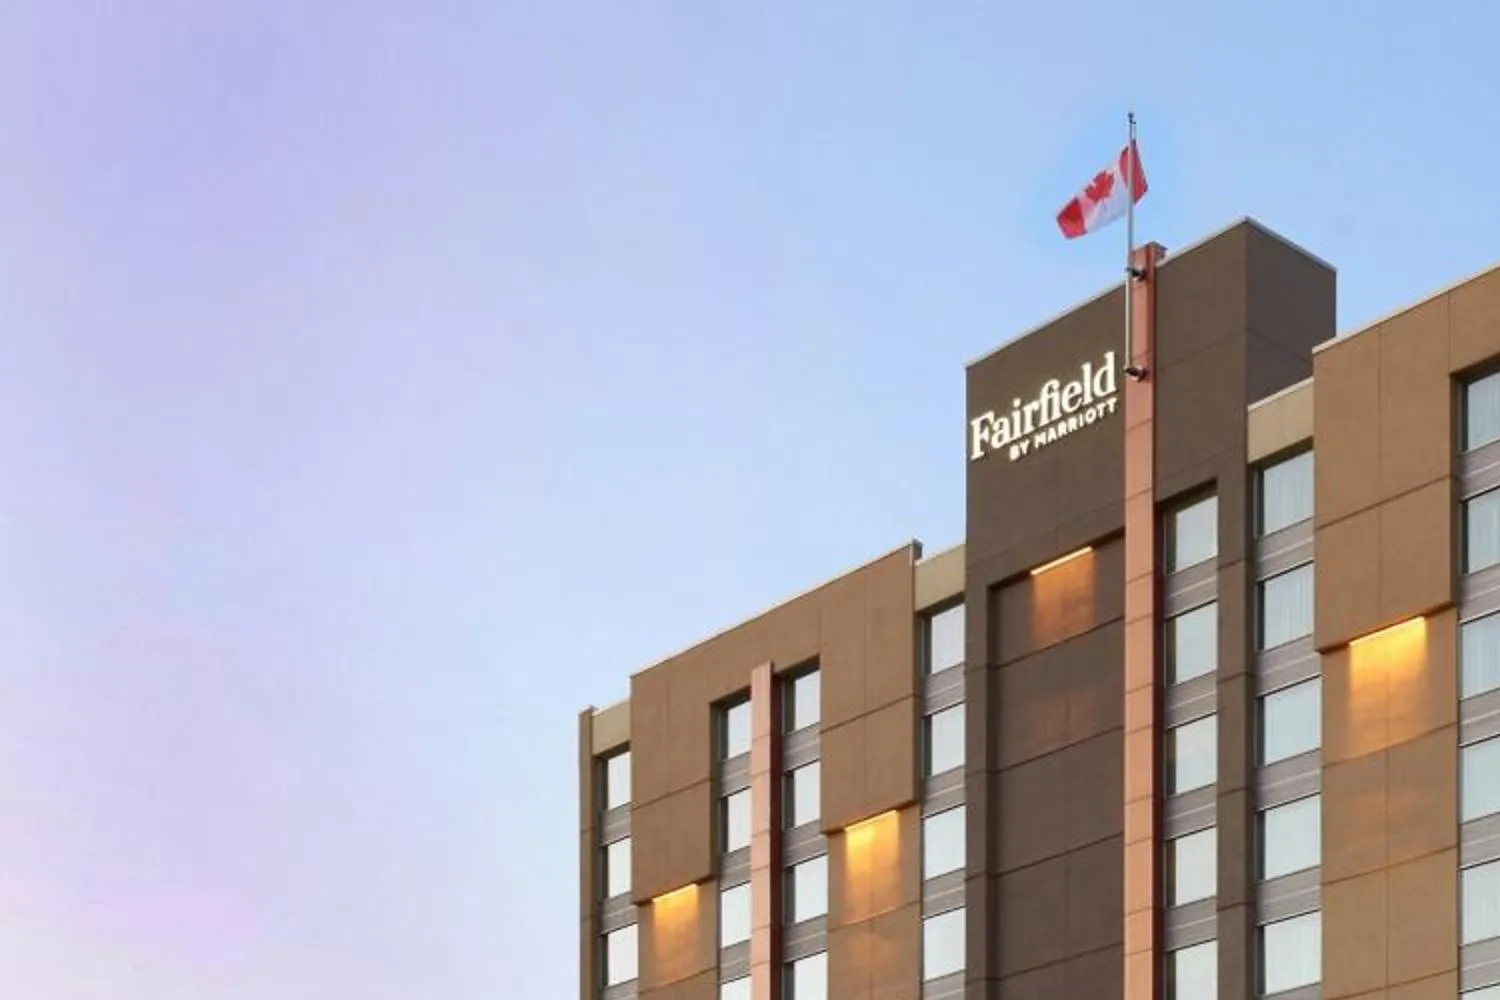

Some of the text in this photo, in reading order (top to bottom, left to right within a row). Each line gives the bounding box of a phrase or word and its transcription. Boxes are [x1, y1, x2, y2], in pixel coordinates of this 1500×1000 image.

[969, 351, 1117, 460] Fairfield
[1009, 398, 1117, 461] BY MARRIOTT
